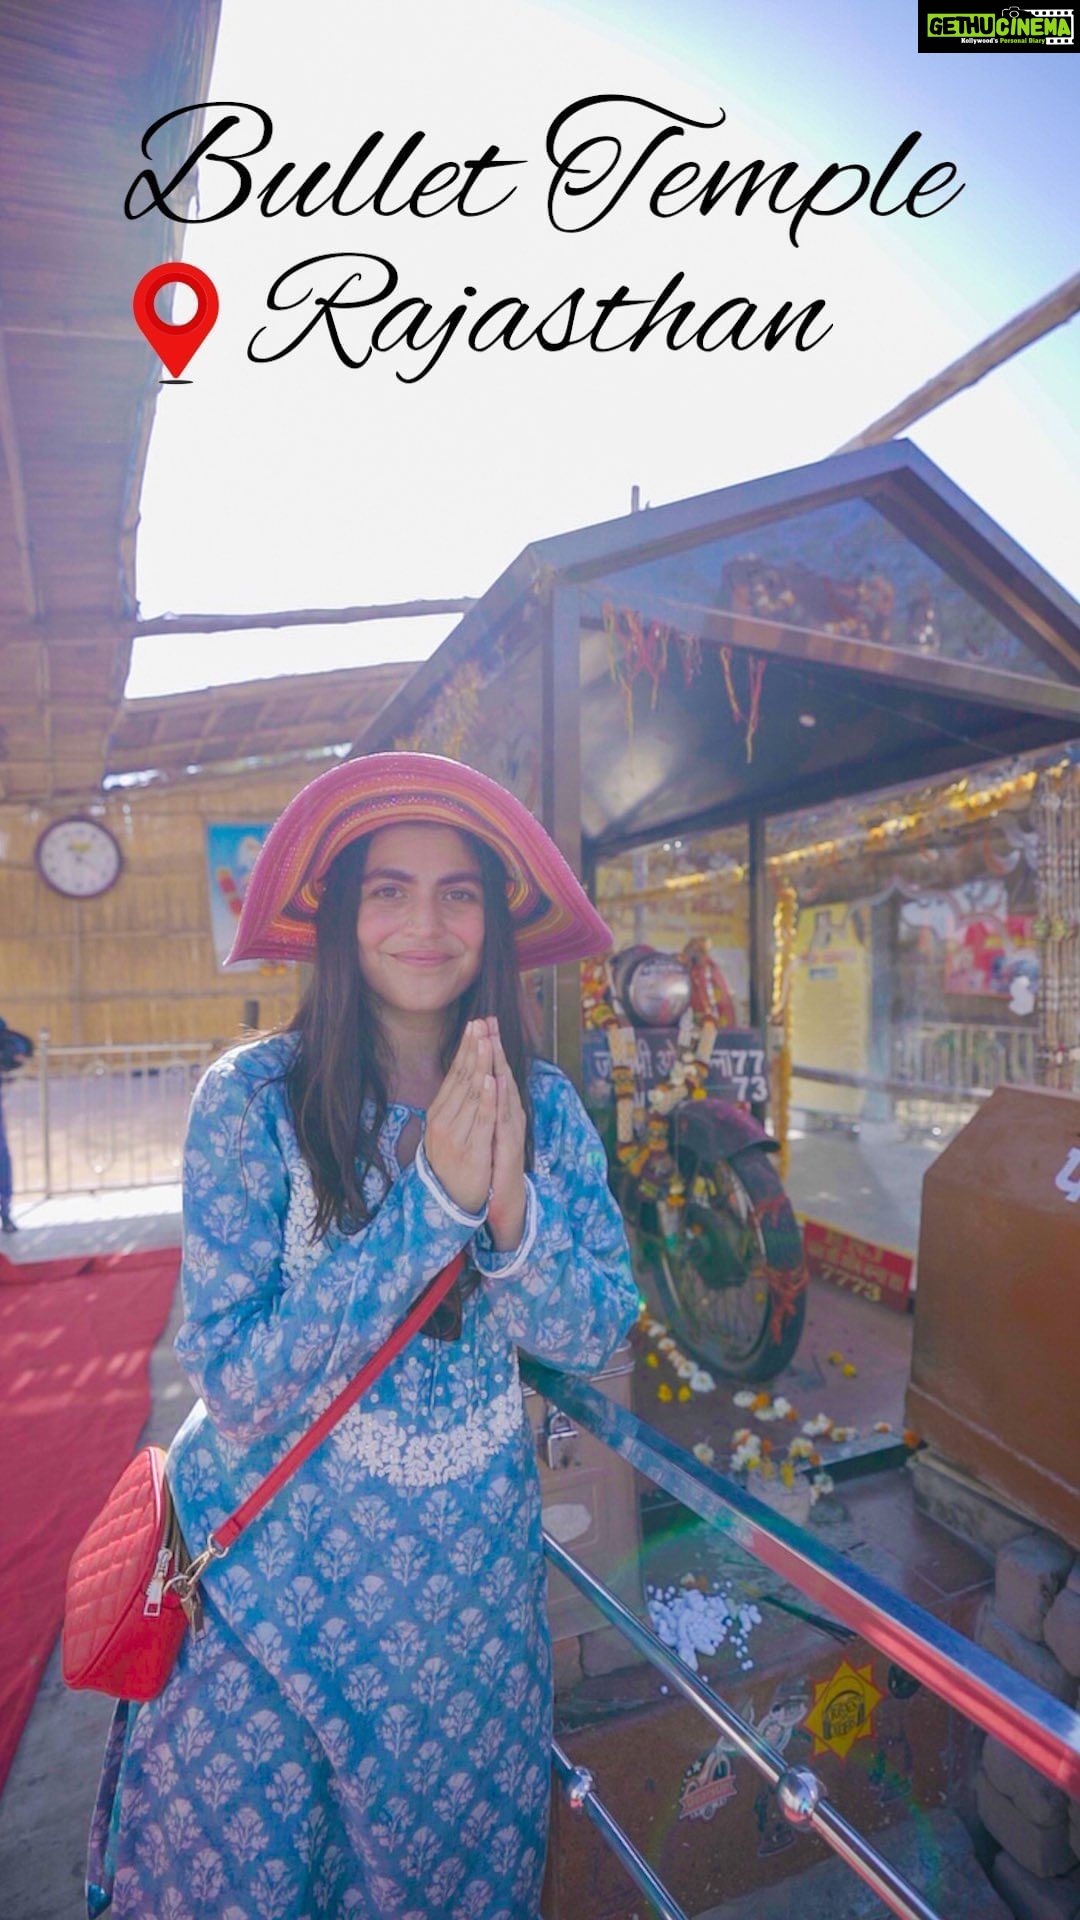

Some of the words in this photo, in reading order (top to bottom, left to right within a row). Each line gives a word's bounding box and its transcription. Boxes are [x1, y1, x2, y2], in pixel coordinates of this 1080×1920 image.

[731, 1050, 765, 1075] 77
[731, 1076, 768, 1101] 73
[821, 1263, 881, 1302] 7773
